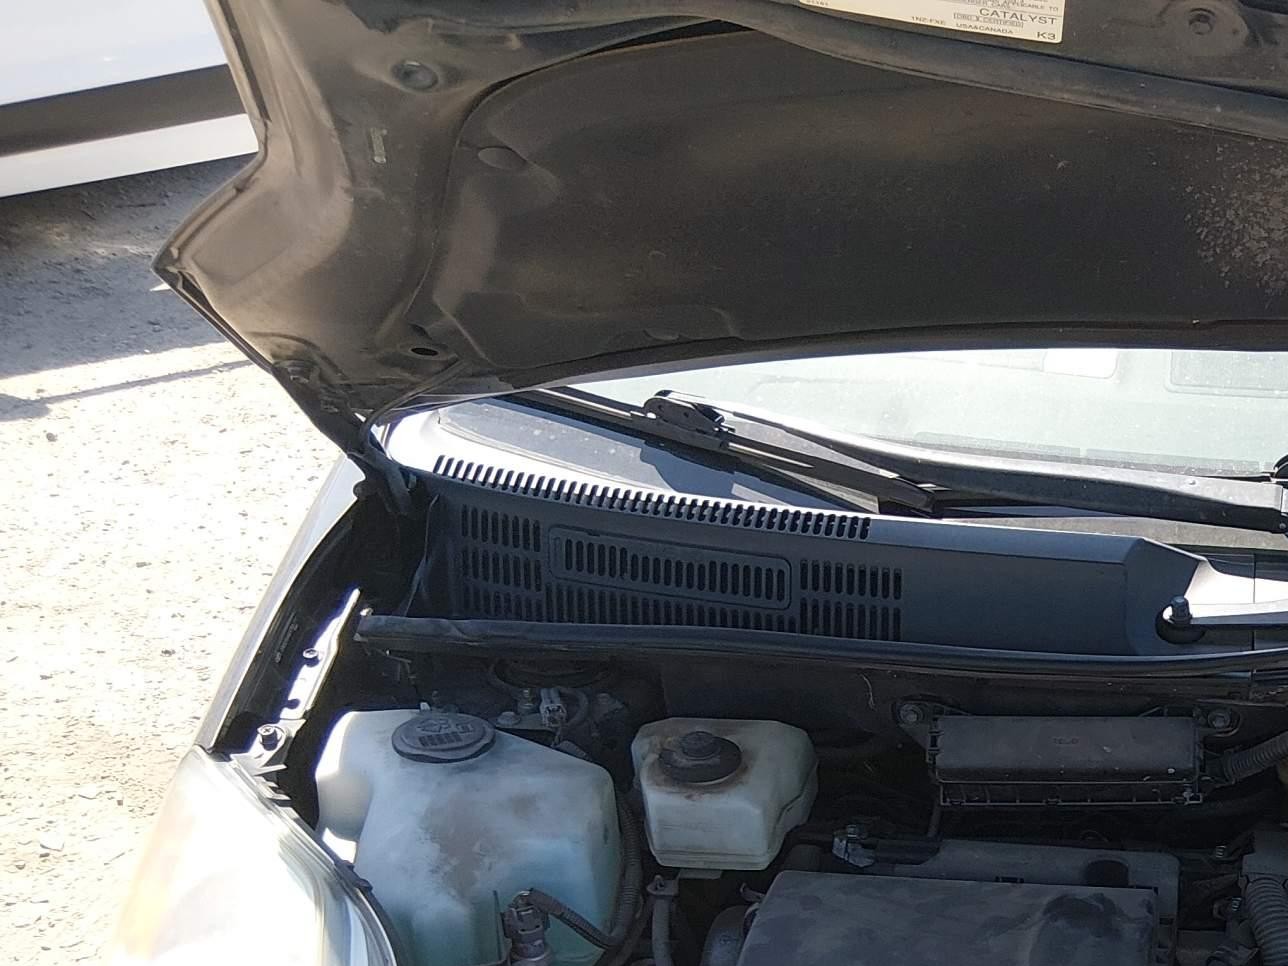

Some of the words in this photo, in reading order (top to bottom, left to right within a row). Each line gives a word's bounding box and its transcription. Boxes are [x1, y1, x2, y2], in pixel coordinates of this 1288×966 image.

[979, 8, 1057, 25] CATALYST
[956, 23, 1014, 34] USA&CANADA
[1036, 31, 1056, 40] K3
